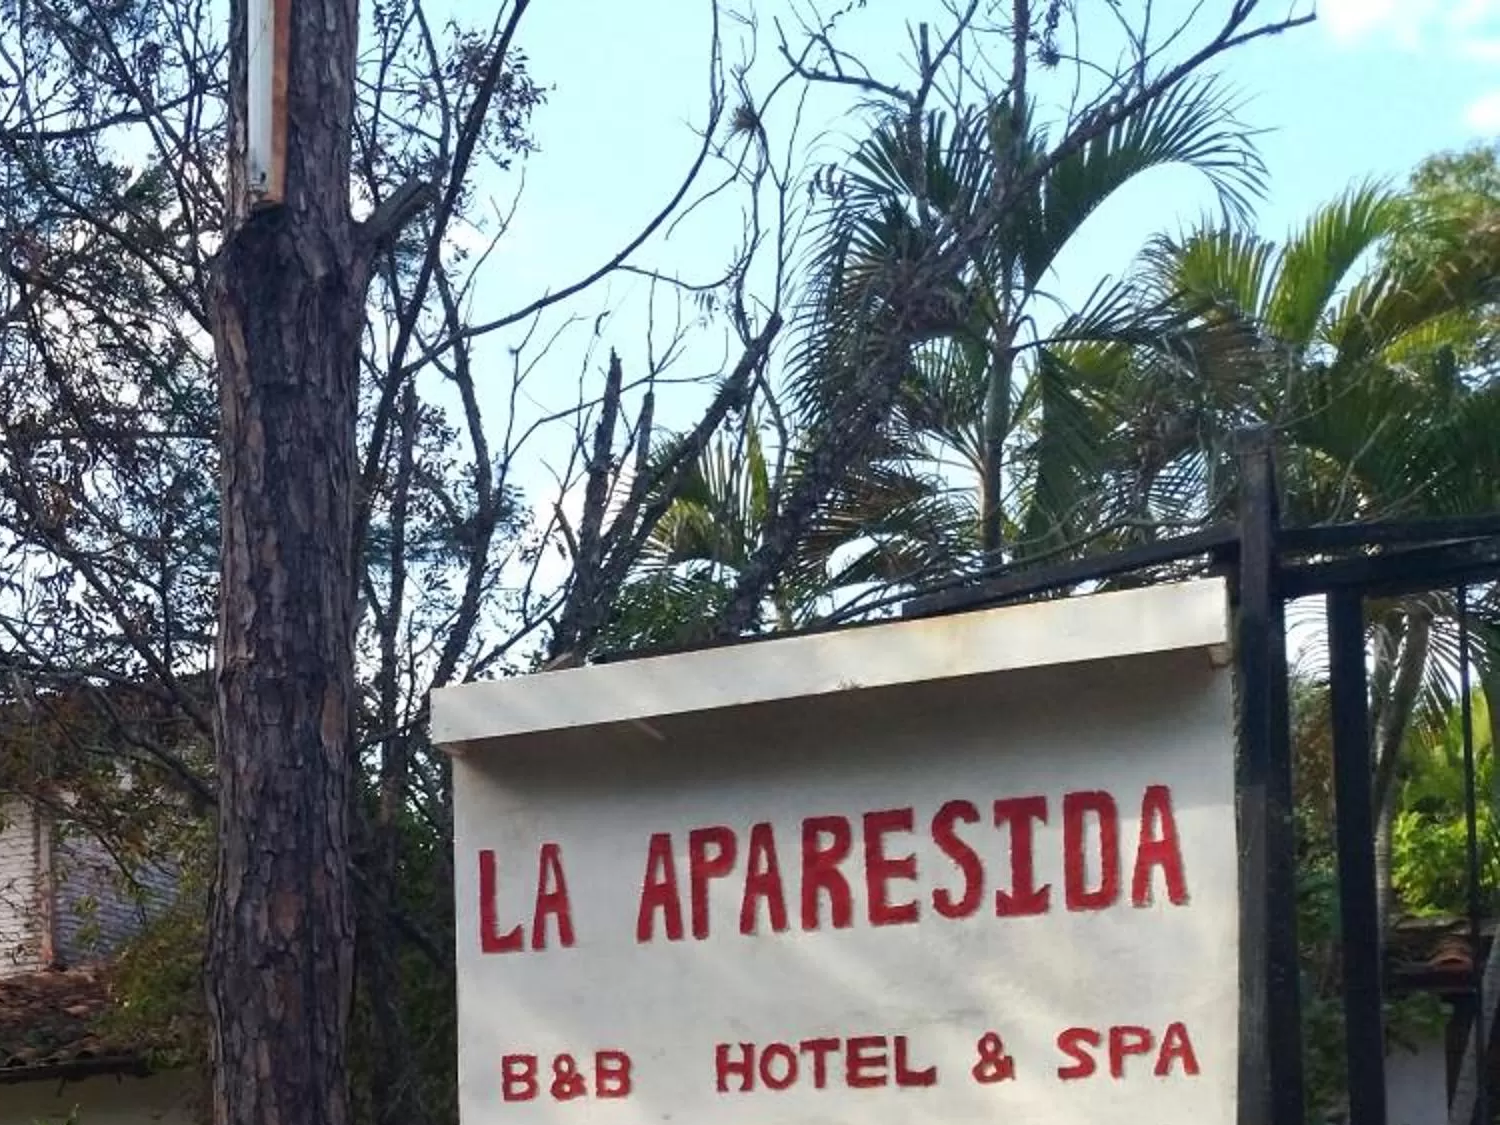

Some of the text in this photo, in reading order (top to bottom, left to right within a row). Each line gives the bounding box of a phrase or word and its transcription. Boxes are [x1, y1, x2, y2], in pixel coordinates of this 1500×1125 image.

[479, 784, 1188, 953] LA APARESIDA
[501, 1021, 1200, 1102] B&B HOTEL & SPA
